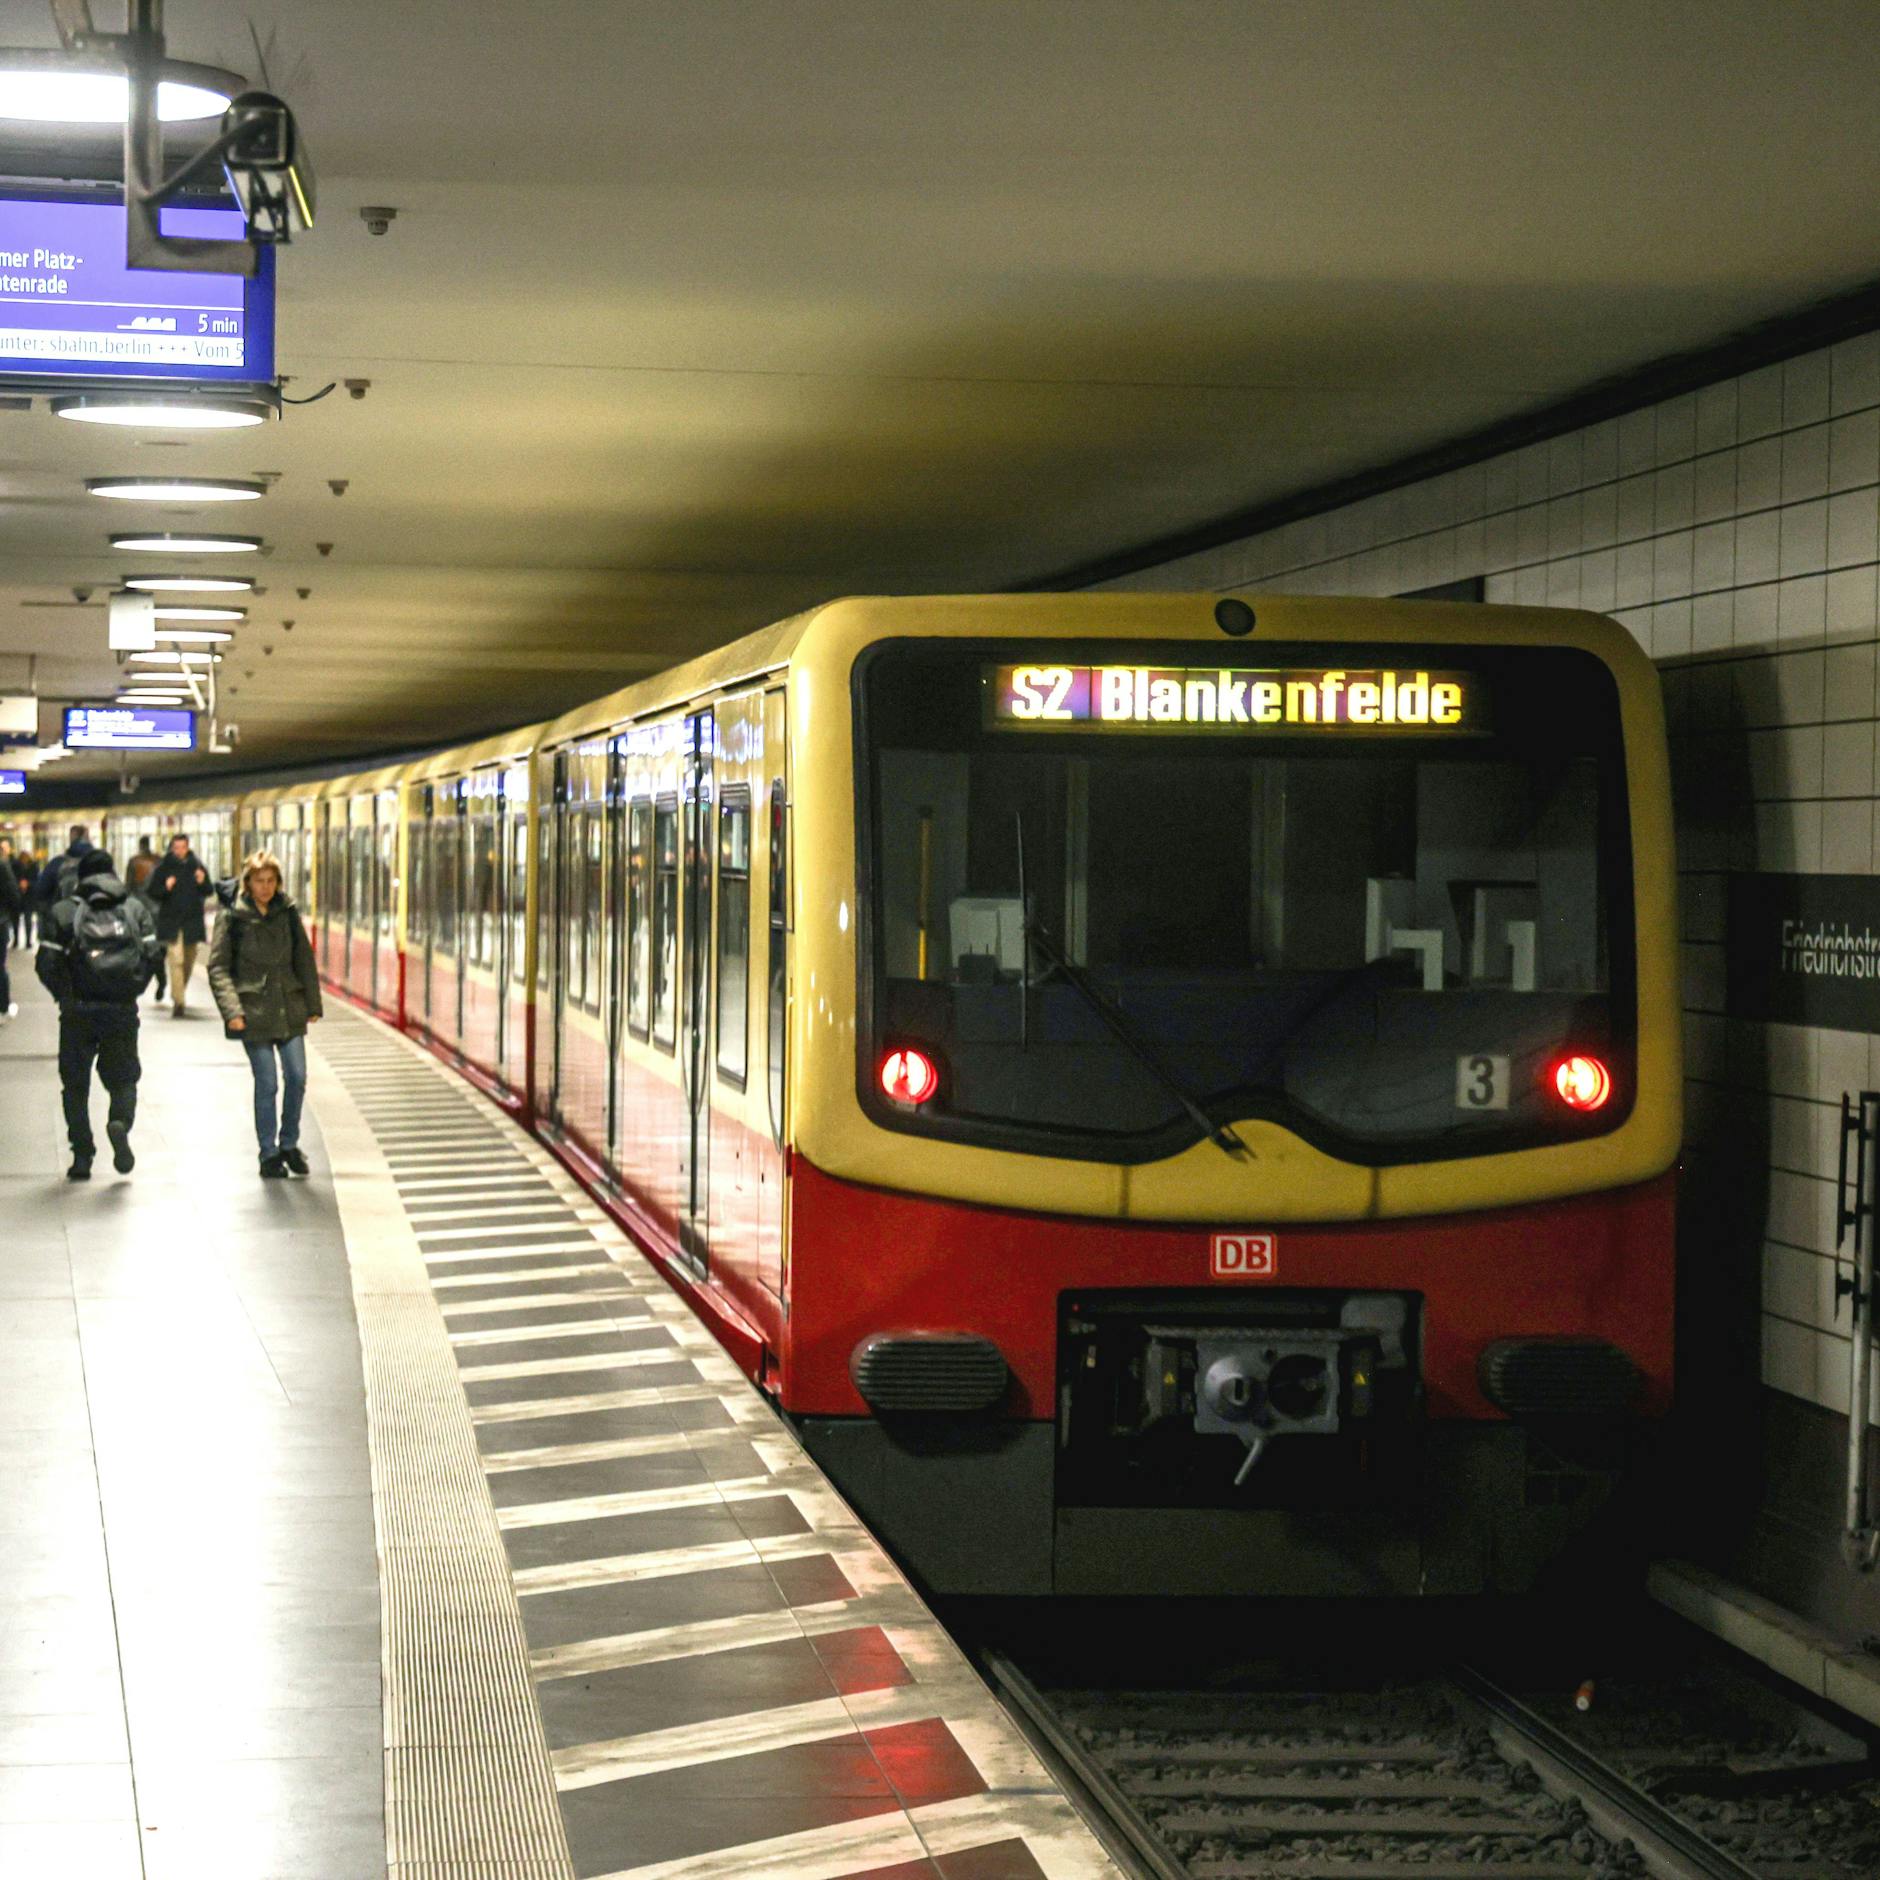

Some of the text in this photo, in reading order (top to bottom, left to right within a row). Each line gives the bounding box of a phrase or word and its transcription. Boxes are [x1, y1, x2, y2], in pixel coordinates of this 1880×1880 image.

[33, 248, 84, 270] Platz-
[198, 313, 238, 333] 5 min
[50, 336, 151, 355] sbahn.berlin
[194, 341, 229, 358] Vom
[1011, 666, 1463, 724] S2 Blankenfelde
[1467, 1056, 1495, 1106] 3
[1219, 1240, 1268, 1270] DB
